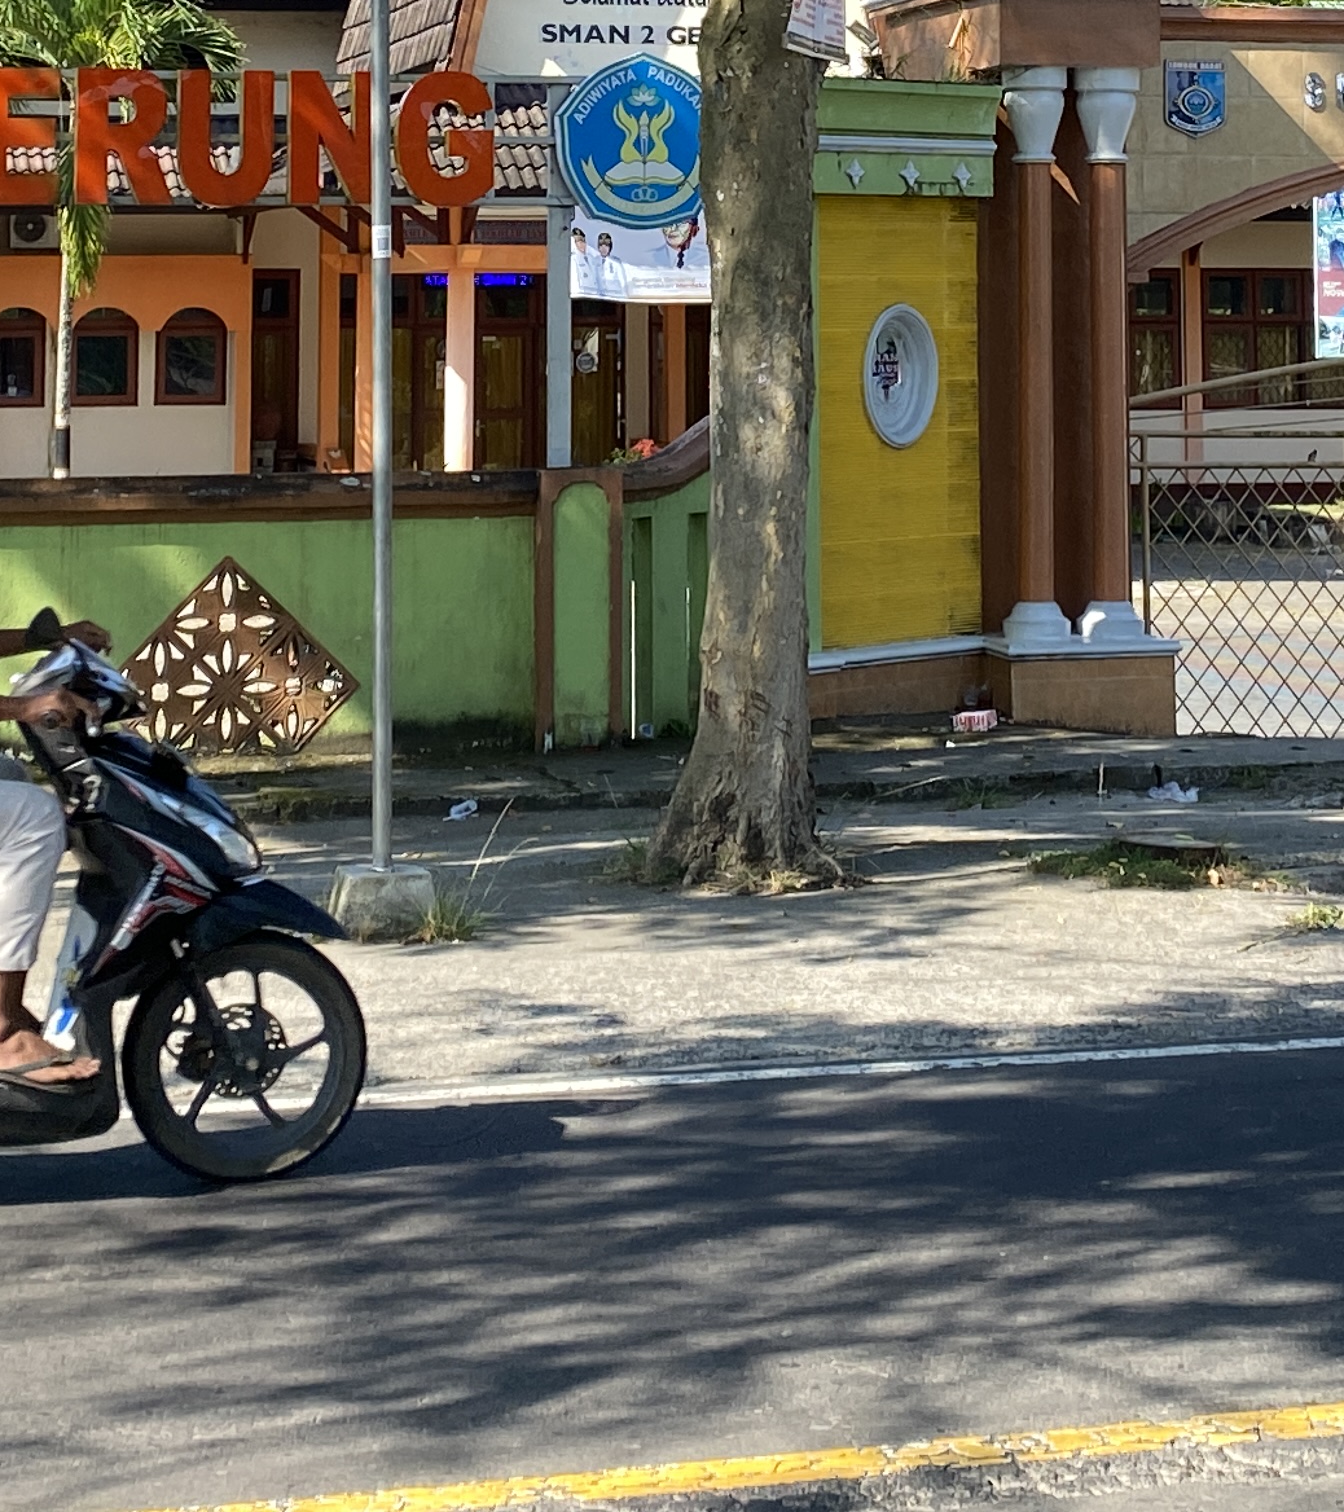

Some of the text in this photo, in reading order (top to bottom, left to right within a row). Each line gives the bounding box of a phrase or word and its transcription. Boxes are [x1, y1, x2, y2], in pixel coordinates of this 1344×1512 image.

[541, 24, 630, 44] SMAN
[641, 25, 655, 44] 2
[573, 65, 702, 125] ADIWIYATA PADUKA
